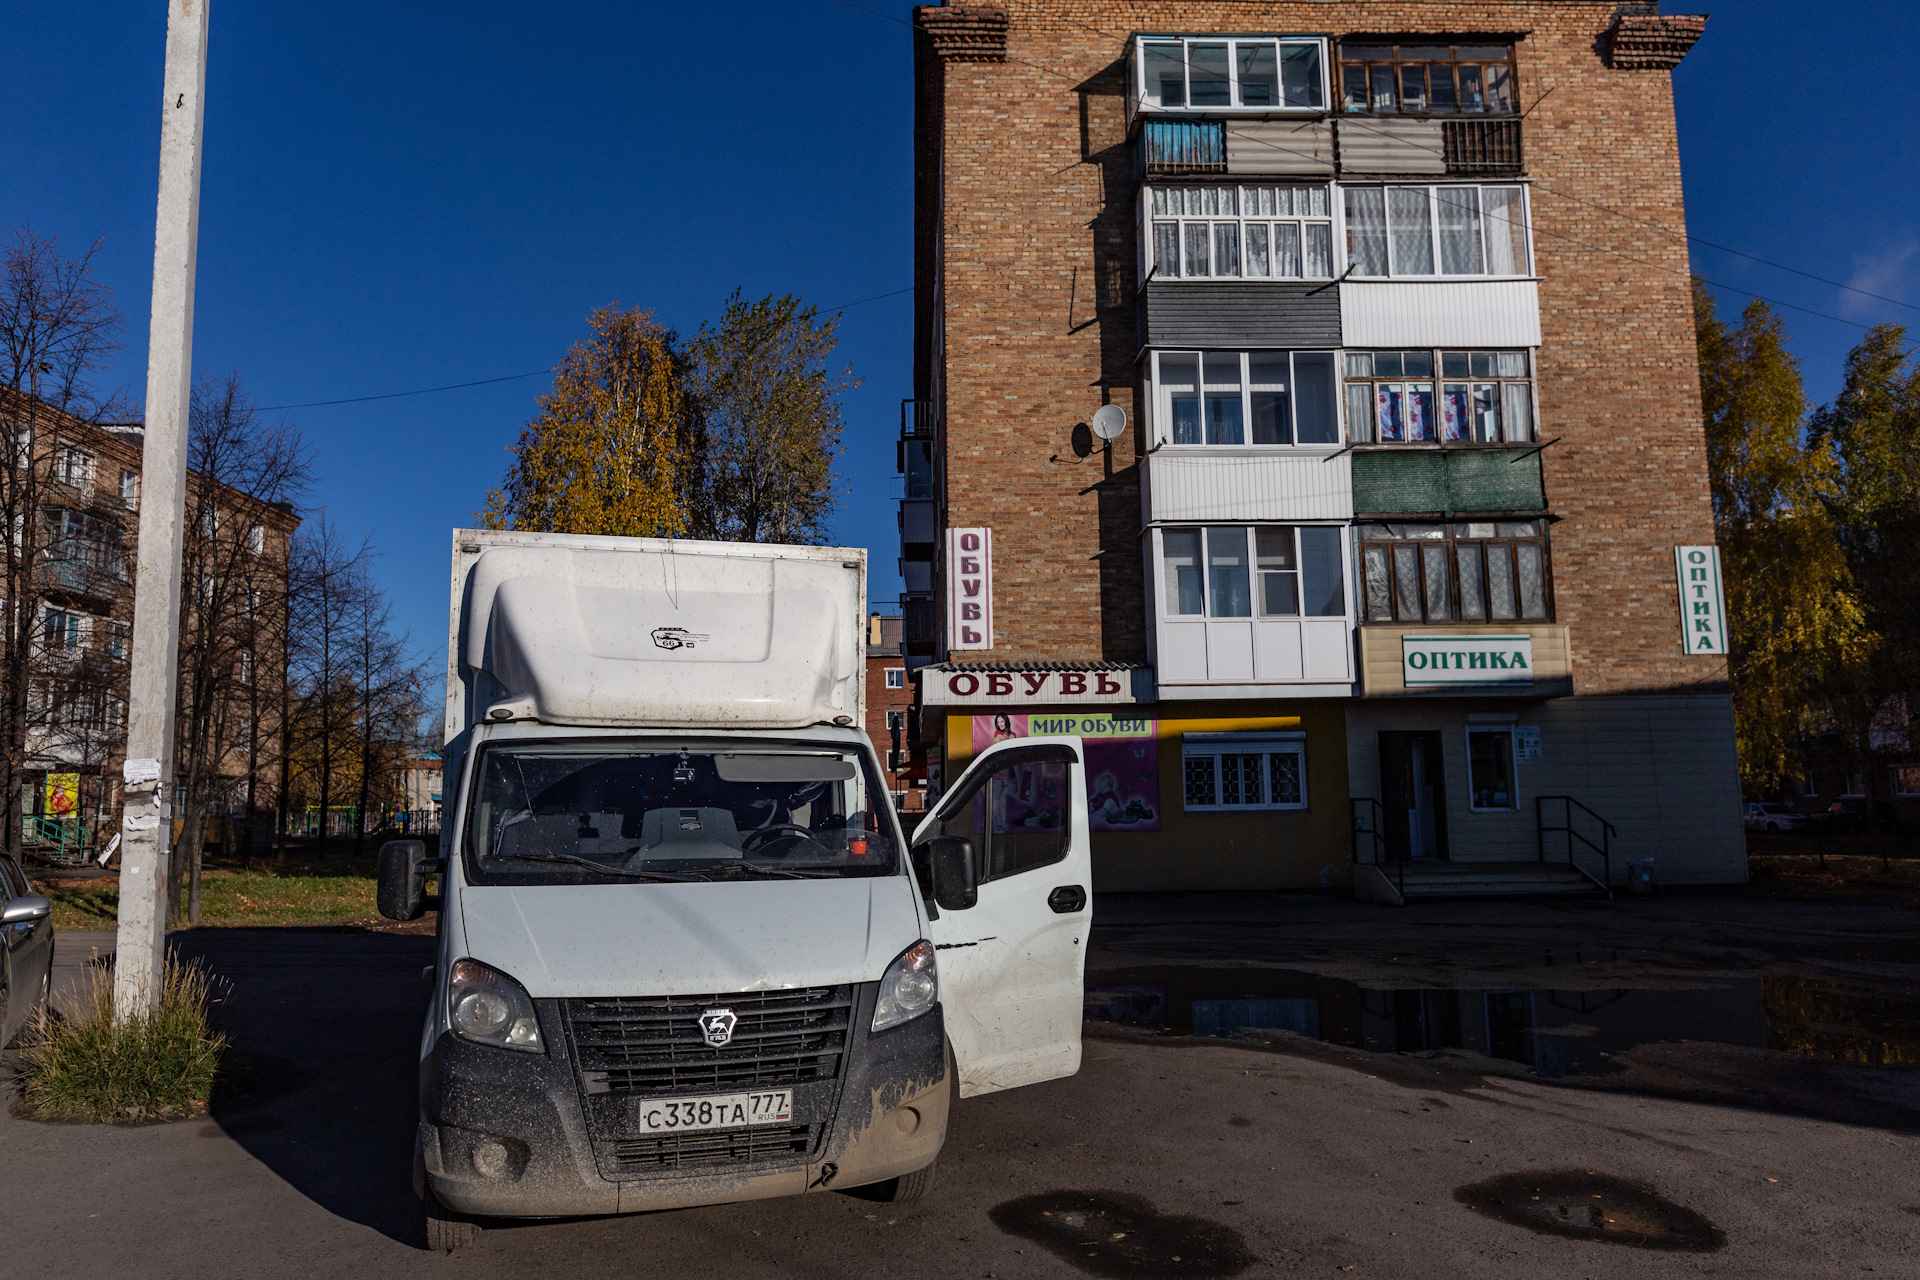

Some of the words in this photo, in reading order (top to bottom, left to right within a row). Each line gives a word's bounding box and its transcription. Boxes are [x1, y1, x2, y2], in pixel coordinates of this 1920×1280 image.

[959, 533, 982, 645] ОБУВЬ
[1687, 550, 1714, 650] ОПТИКА
[1408, 651, 1529, 670] ОПТИКА
[948, 672, 1121, 696] ОБУВЬ
[1033, 718, 1077, 734] МИР
[1080, 718, 1146, 735] ОБУВИ
[750, 1093, 786, 1114] 777
[757, 1112, 776, 1121] RUS
